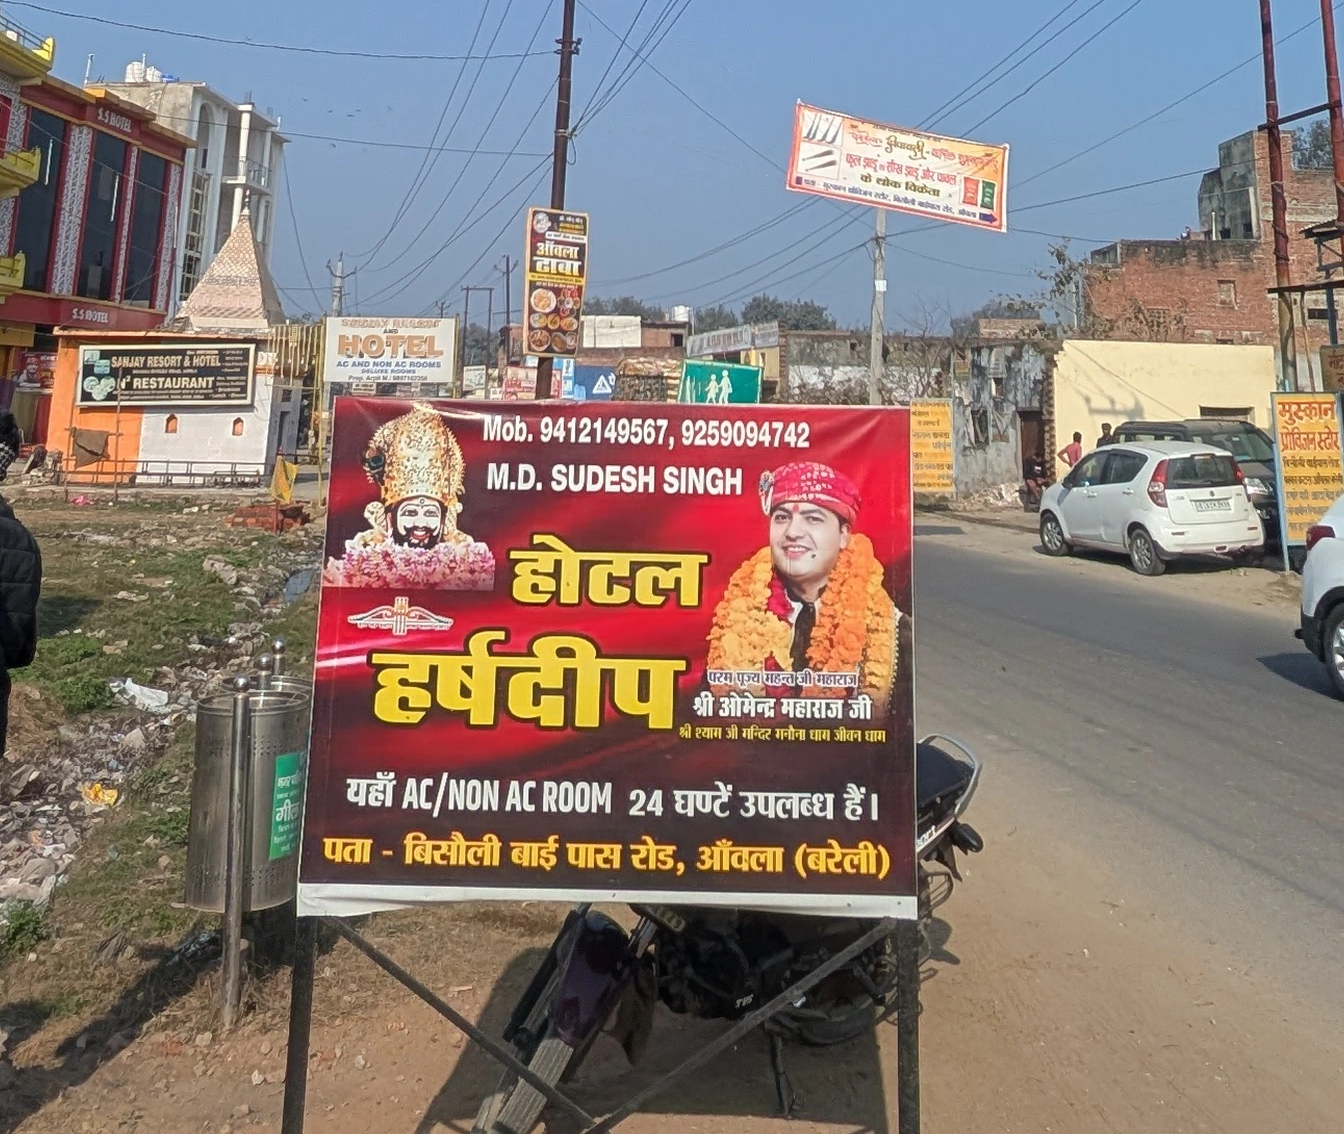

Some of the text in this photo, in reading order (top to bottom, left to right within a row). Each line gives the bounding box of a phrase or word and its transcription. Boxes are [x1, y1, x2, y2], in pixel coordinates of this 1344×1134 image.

[85, 311, 109, 323] HOTEL
[393, 320, 441, 328] RESORT
[338, 334, 444, 359] HOTEL
[111, 356, 145, 368] SANJAY
[147, 355, 181, 367] RESORT
[183, 355, 191, 367] &
[192, 355, 221, 366] HOTEL
[133, 377, 215, 389] RESTAURANT
[1277, 401, 1337, 424] मुस्कान
[483, 414, 810, 451] Mob. 9412149567, 9259094742
[1280, 426, 1341, 452] प्रोविजन स्टोर
[487, 463, 743, 496] M.D. SUDESH SINGH
[509, 534, 708, 607] होटल
[371, 630, 687, 730] हर्षदीप
[708, 669, 858, 687] परम पूज्य महन्त जी महाराज
[693, 690, 873, 720] श्री ओमेन्द्र महाराज जी
[679, 723, 692, 739] श्री
[695, 726, 722, 740] श्याम
[725, 724, 738, 740] जी
[742, 723, 771, 741] मन्दिर
[809, 727, 831, 742] धाम
[834, 726, 862, 743] जीवन
[865, 729, 886, 743] धाम
[346, 771, 396, 807] यहाँ
[402, 772, 499, 817] AC/NON
[506, 781, 537, 811] AC
[542, 781, 613, 814] ROOM
[629, 789, 663, 817] 24
[673, 781, 734, 817] घण्टें
[739, 792, 835, 820] उपलब्ध
[323, 838, 373, 864] पता
[403, 831, 502, 866] बिसौली
[510, 835, 559, 871] बाई
[566, 843, 623, 869] पास
[630, 835, 686, 876] रोड,
[696, 839, 785, 872] आँवला
[794, 839, 891, 880] (बरेली)
